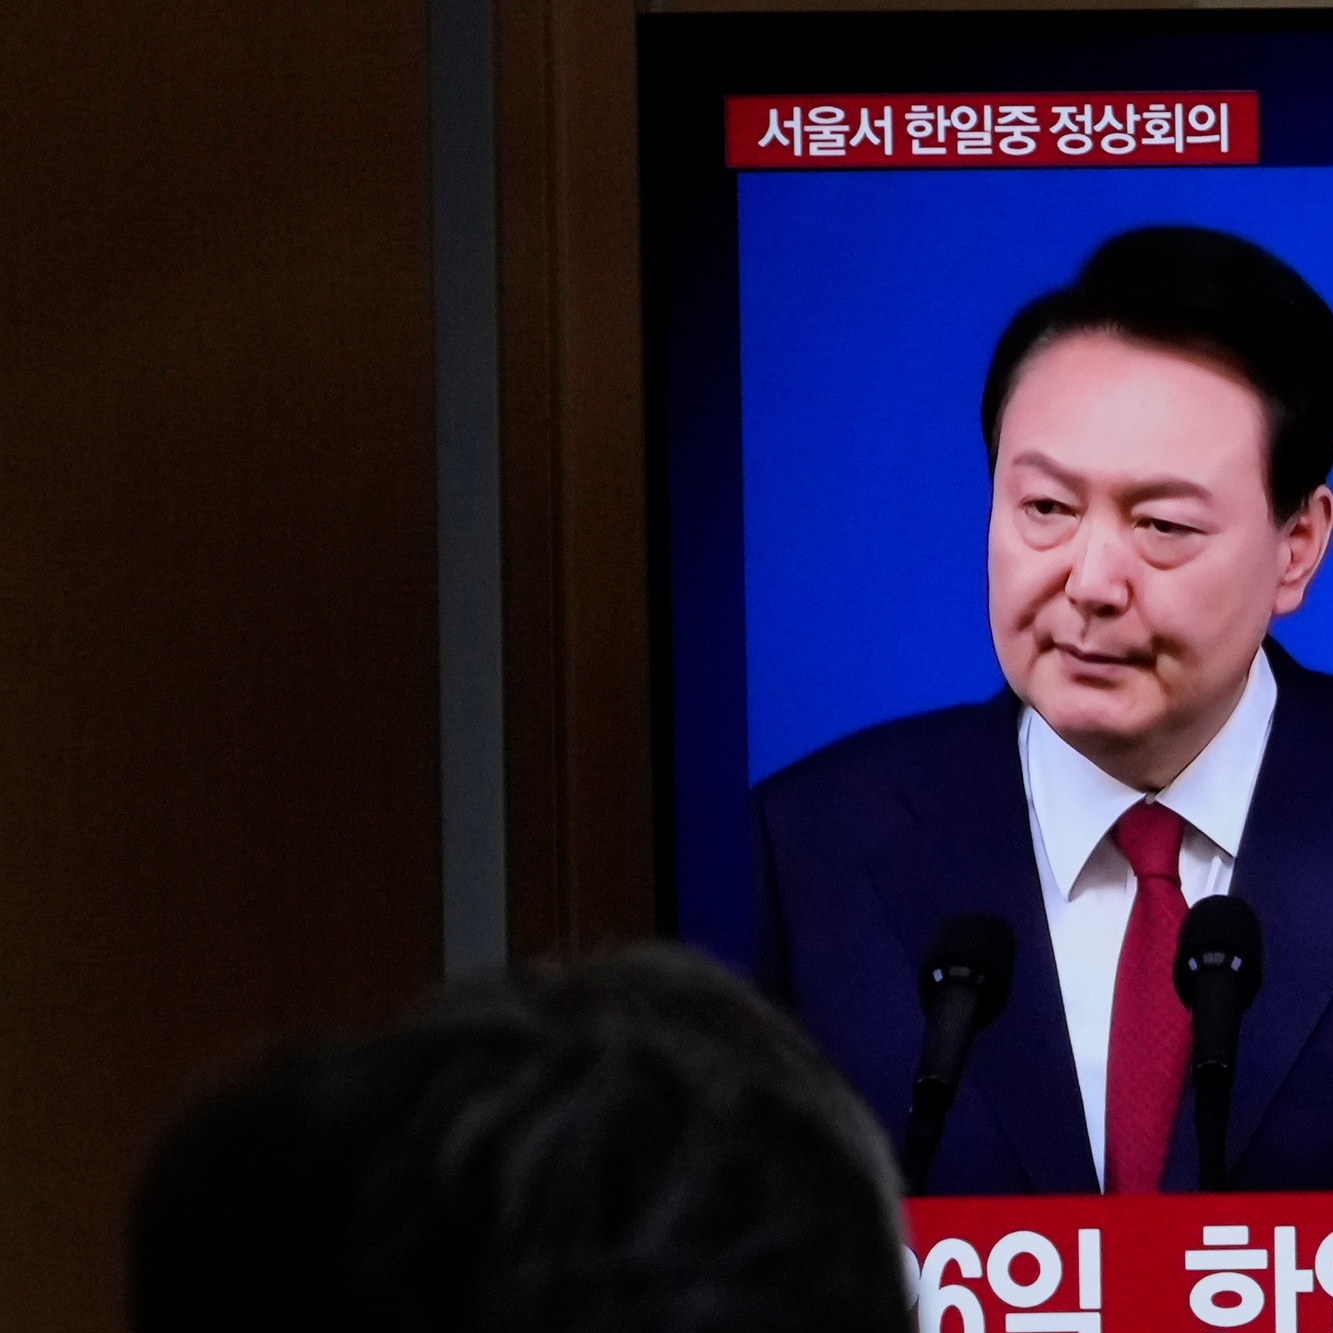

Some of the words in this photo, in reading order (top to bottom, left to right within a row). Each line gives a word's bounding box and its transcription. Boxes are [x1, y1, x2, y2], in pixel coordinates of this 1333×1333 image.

[757, 104, 894, 157] 서울서
[903, 104, 1042, 157] 한일중
[1048, 102, 1230, 156] 정상회의
